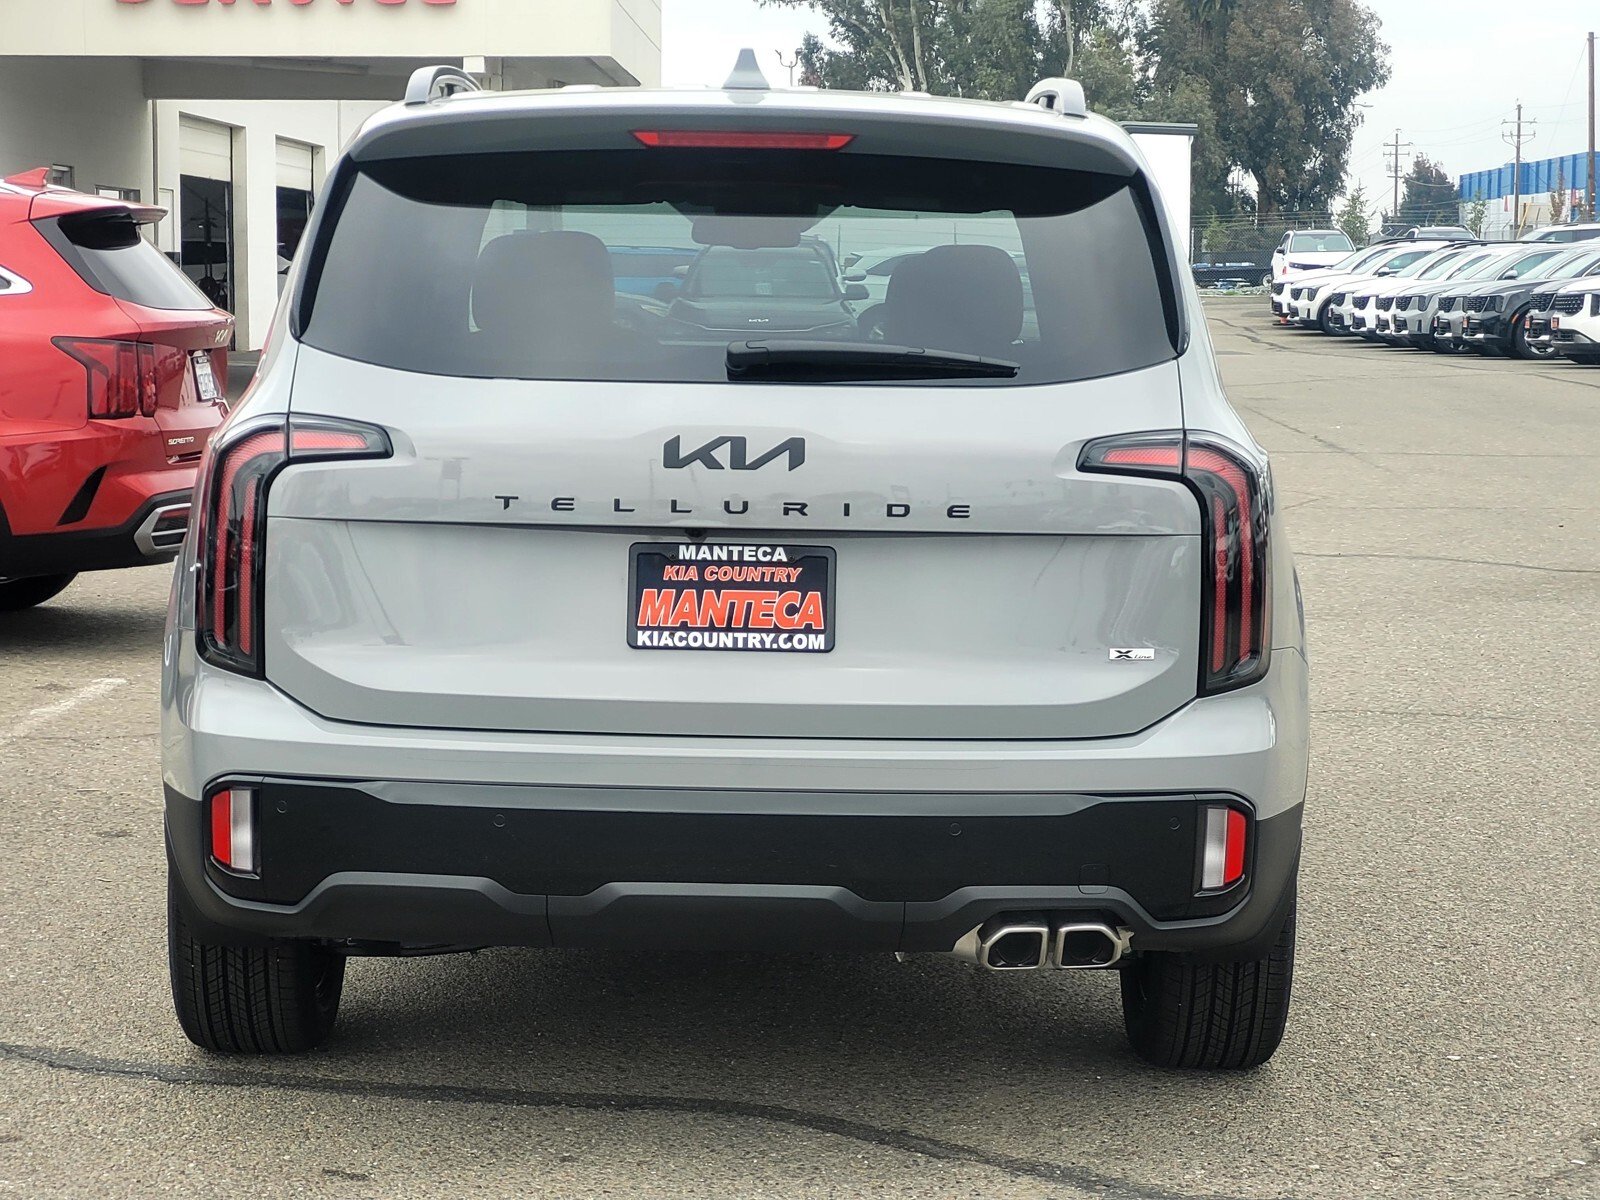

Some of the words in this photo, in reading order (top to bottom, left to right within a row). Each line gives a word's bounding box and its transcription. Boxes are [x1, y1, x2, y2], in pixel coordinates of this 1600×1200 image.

[663, 435, 806, 471] KIA
[495, 495, 971, 519] TELLURIDE
[678, 545, 788, 562] MANTECA
[663, 565, 698, 580] KIA
[704, 566, 802, 582] COUNTRY
[637, 589, 825, 629] MANTECA
[637, 631, 825, 650] KIACOUNTRY.COM
